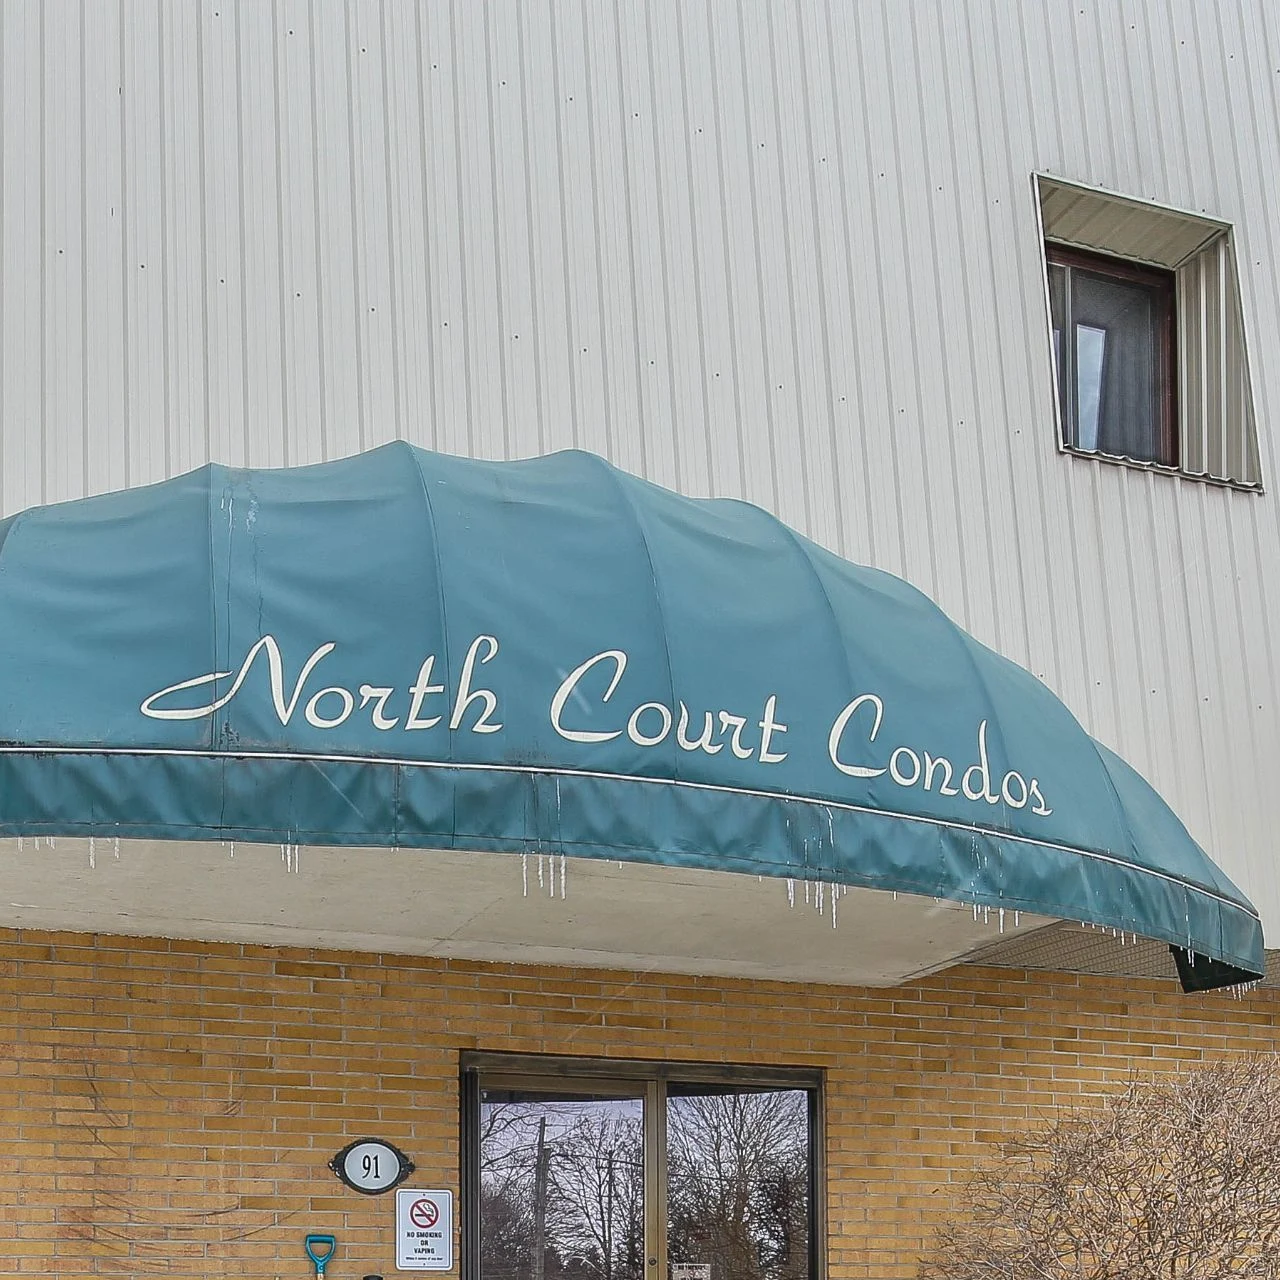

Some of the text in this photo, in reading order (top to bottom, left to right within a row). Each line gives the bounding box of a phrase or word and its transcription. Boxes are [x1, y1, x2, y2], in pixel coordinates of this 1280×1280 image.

[140, 634, 1053, 816] North Court Condos
[362, 1155, 380, 1179] 91
